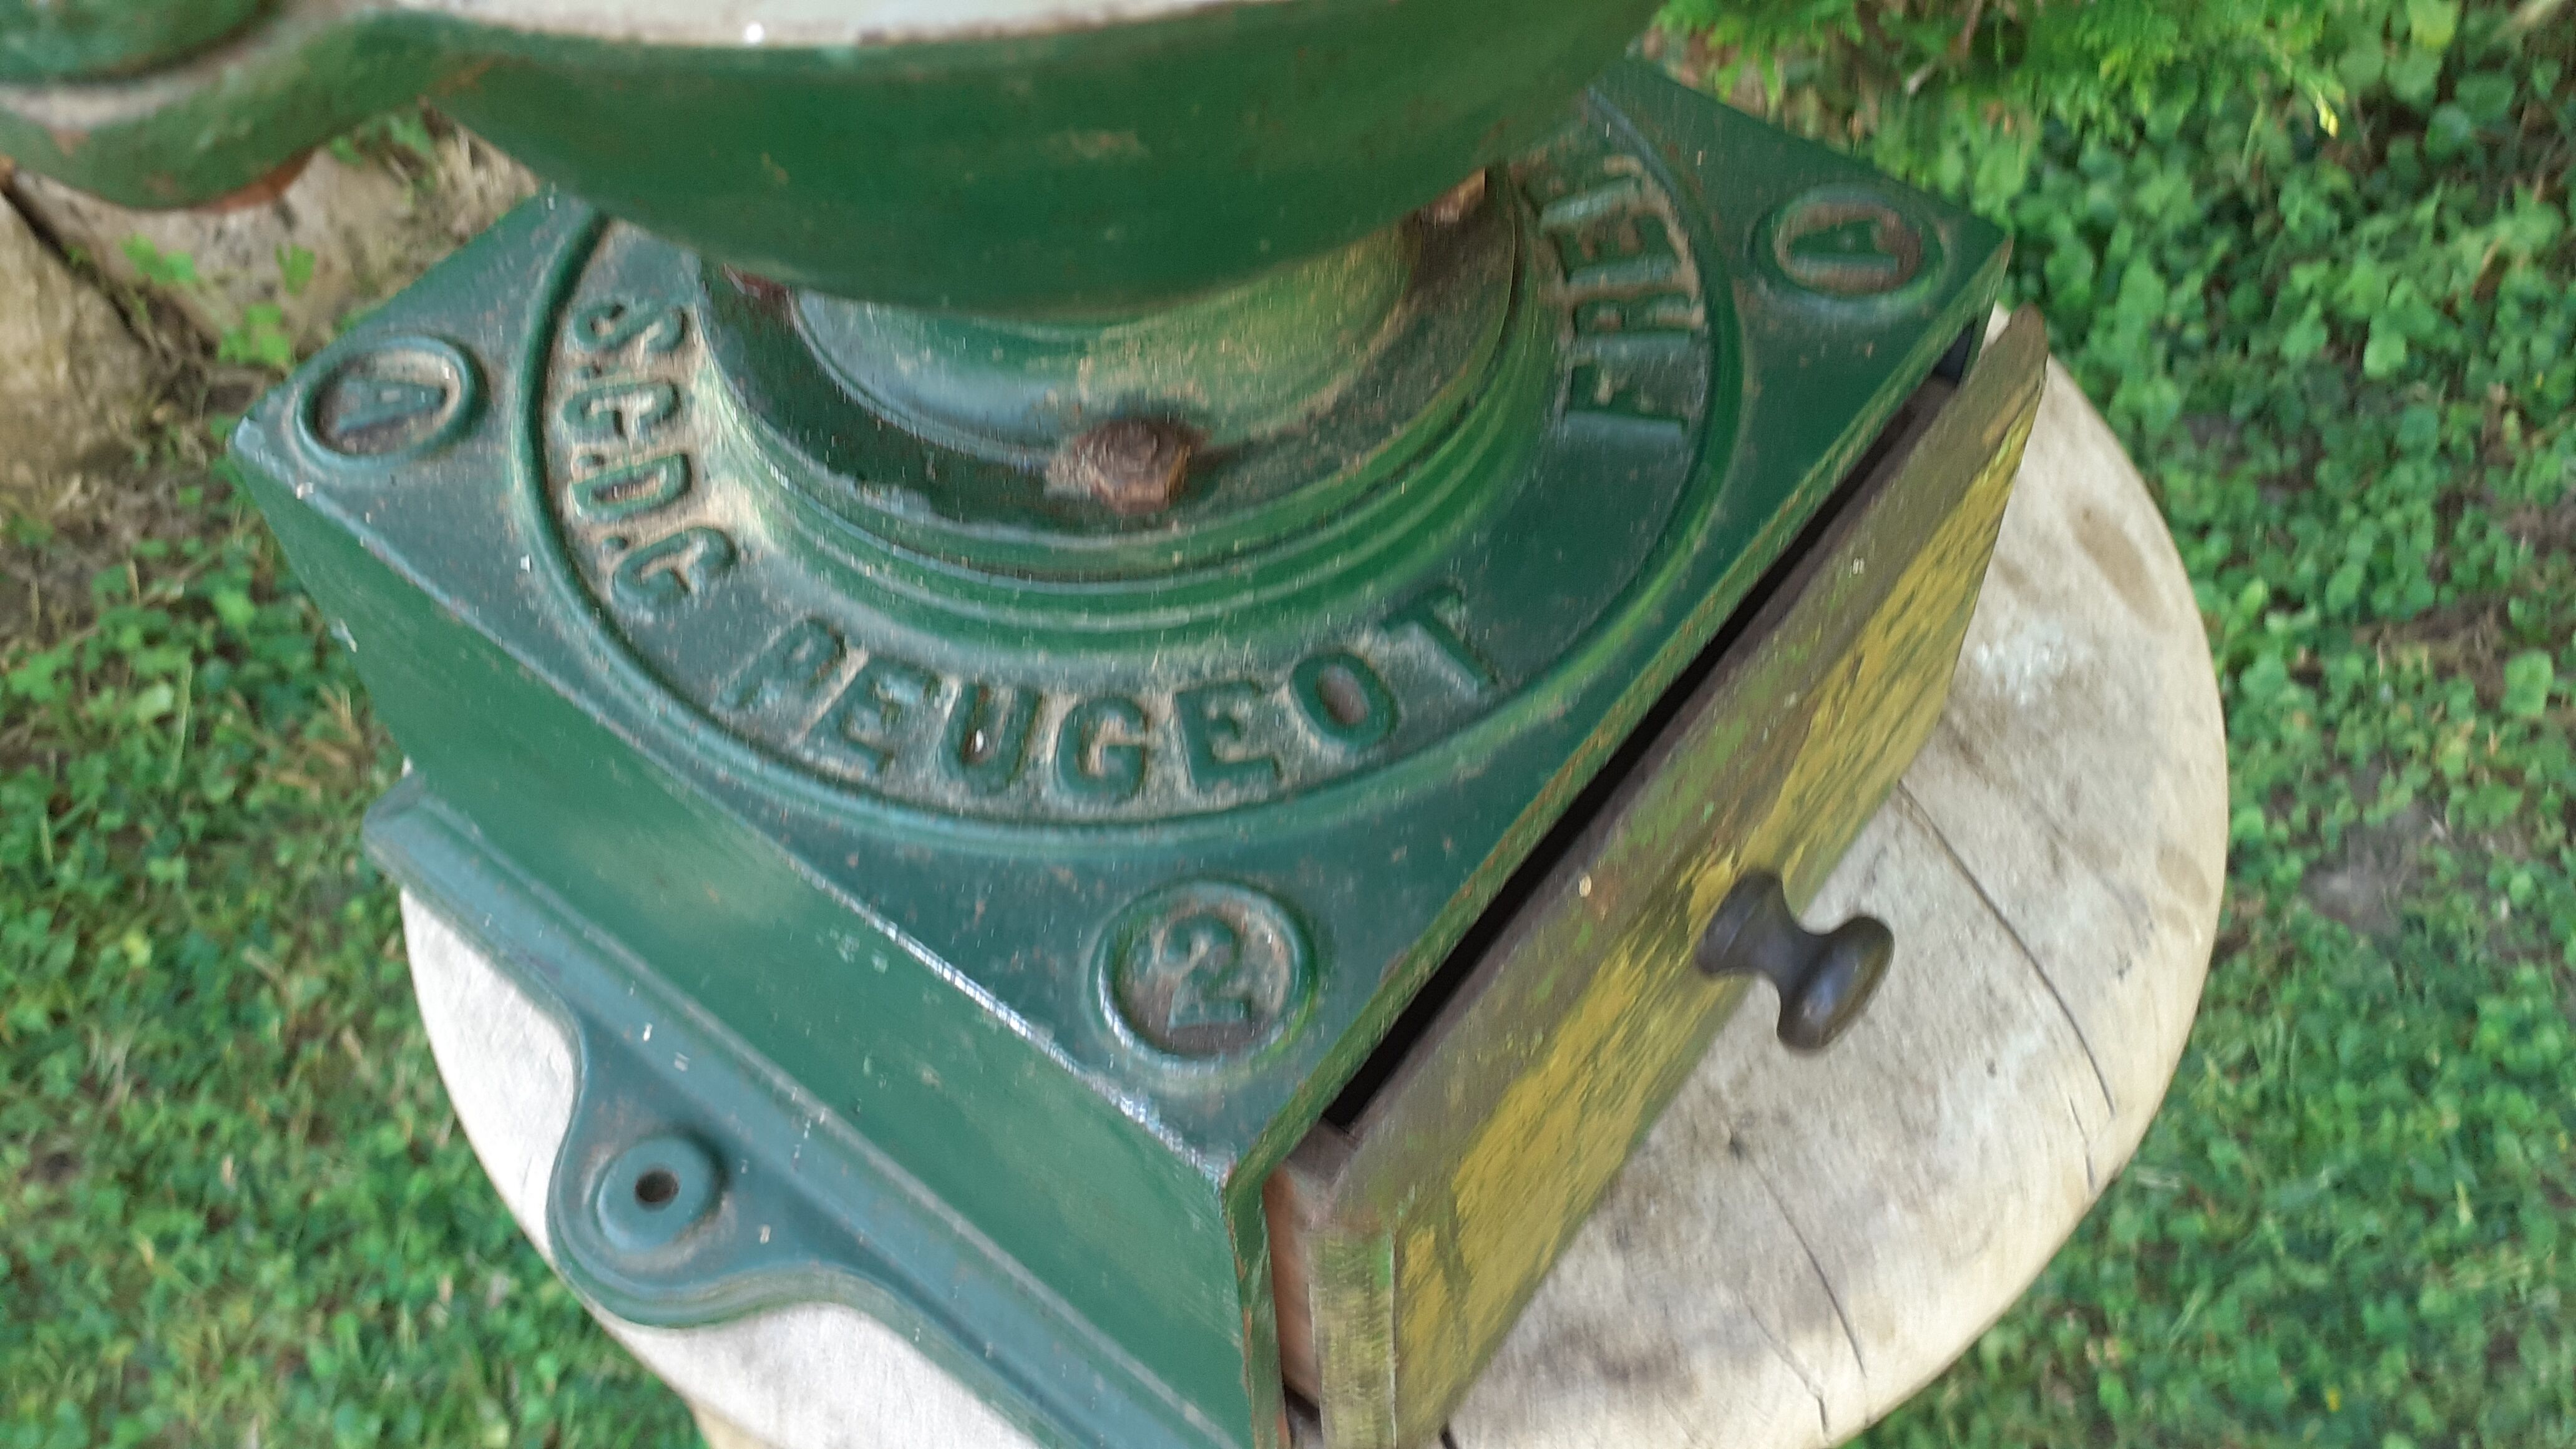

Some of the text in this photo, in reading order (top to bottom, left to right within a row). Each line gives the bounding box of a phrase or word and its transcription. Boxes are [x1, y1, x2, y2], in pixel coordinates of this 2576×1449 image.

[336, 378, 446, 433] A
[716, 590, 1495, 800] PEUGEOT
[1162, 912, 1251, 1030] 2
